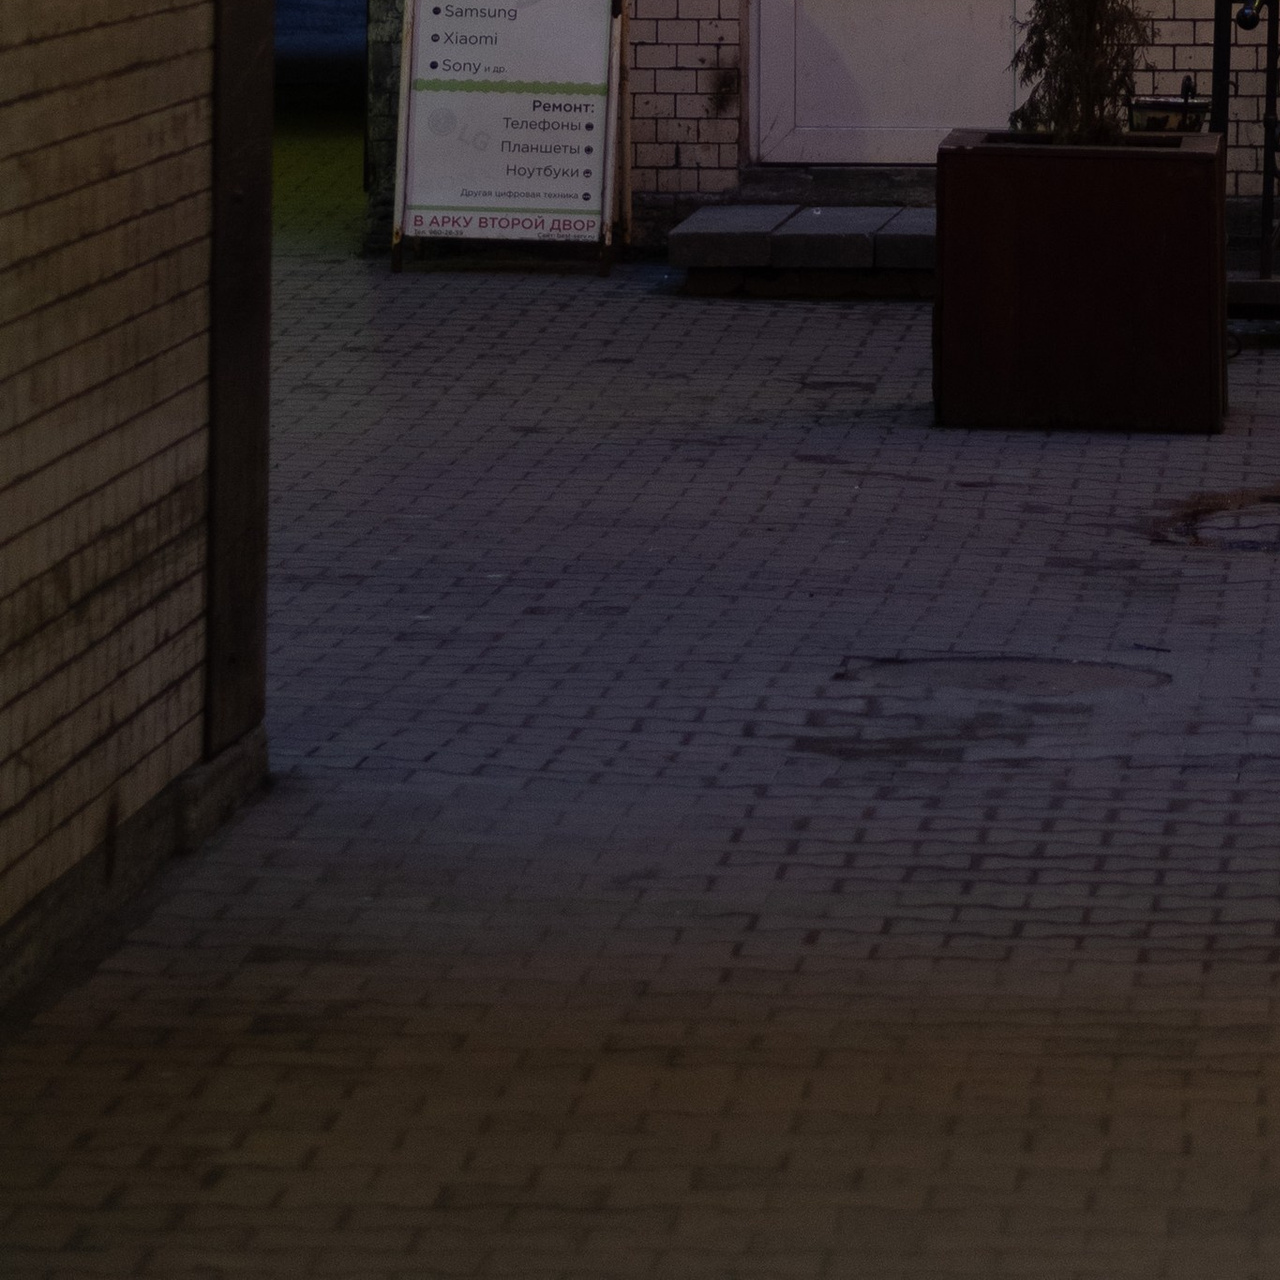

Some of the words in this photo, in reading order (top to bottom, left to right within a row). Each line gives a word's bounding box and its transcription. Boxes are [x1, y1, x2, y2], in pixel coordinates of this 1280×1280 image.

[444, 4, 518, 21] Samsung
[443, 32, 499, 46] Xiaomi
[441, 58, 482, 74] Sony
[492, 66, 508, 75] др.
[532, 100, 595, 114] Ремонт:
[503, 117, 581, 132] Телефоны
[500, 141, 581, 155] Планшеты
[506, 164, 580, 179] Ноутбуки
[460, 188, 493, 198] Другая
[495, 190, 541, 199] цифровая
[543, 191, 579, 200] техника
[414, 214, 424, 227] В
[429, 215, 474, 228] АРКУ
[478, 215, 545, 230] ВТОРОЙ
[550, 218, 597, 232] ДВОР
